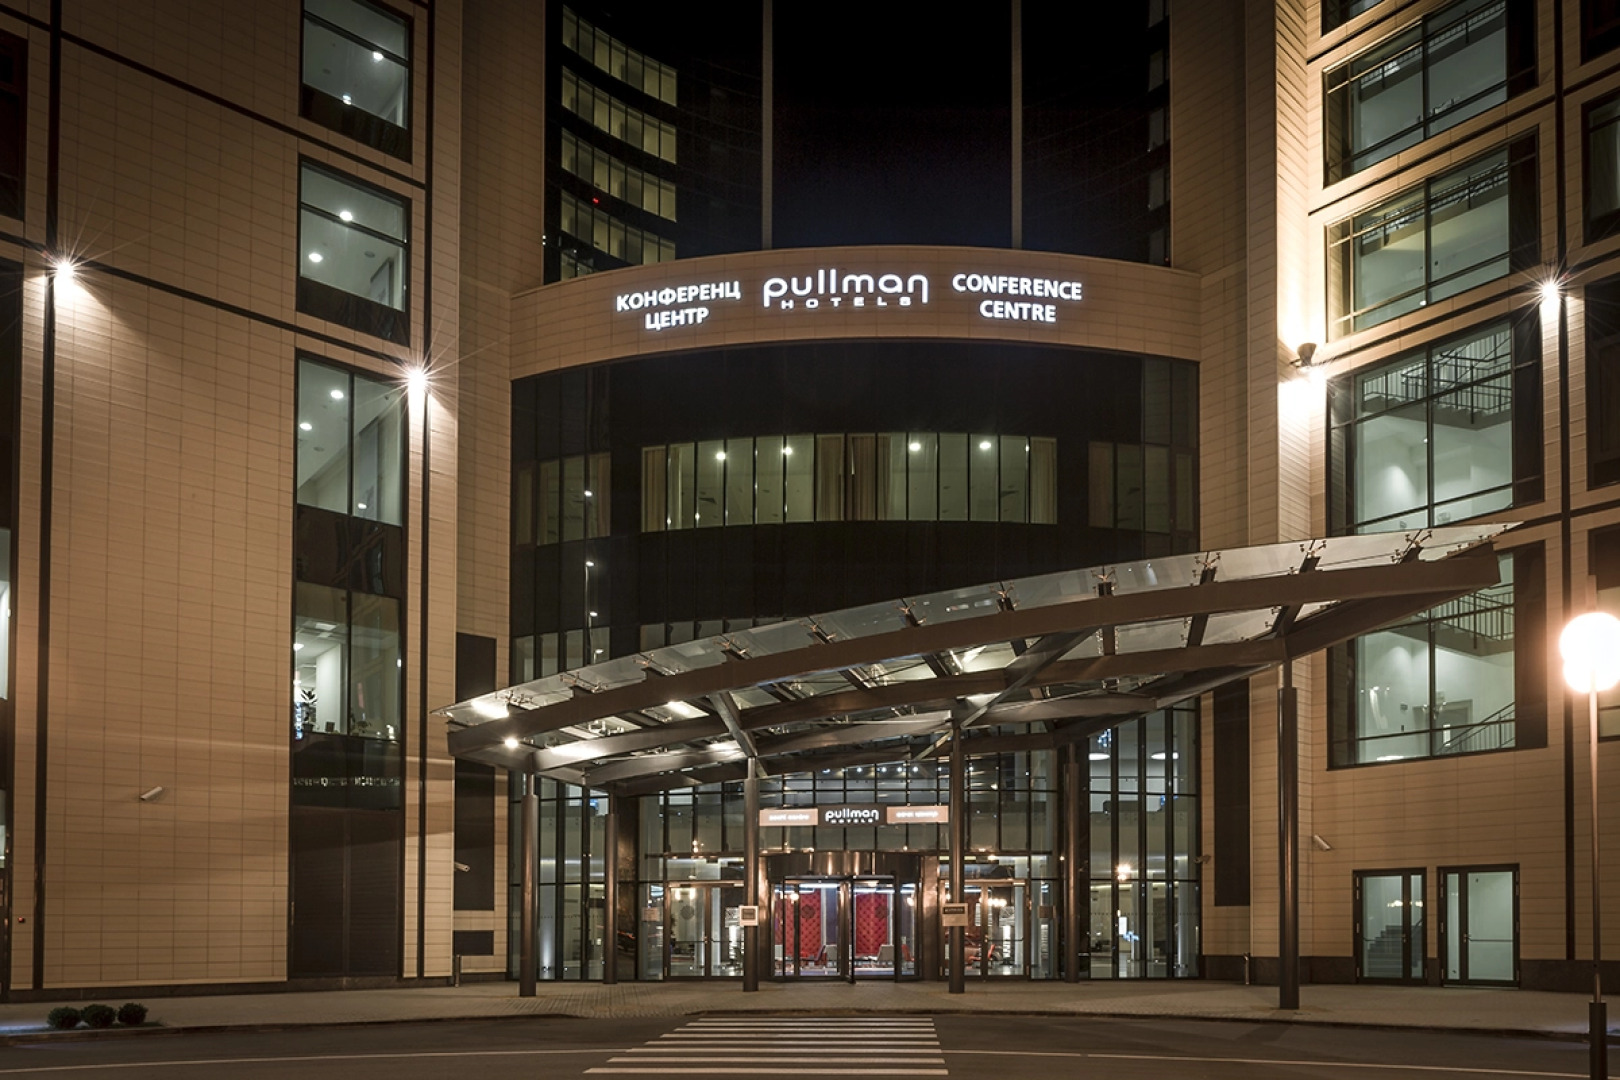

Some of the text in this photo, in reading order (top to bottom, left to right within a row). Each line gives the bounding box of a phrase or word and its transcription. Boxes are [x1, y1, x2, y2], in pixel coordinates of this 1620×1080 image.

[616, 280, 741, 312] КОНФЕРЕНЦ
[762, 268, 928, 308] pullman
[952, 273, 1082, 300] CONFERENCE
[645, 306, 709, 331] ЦЕНТР
[979, 300, 1056, 322] CENTRE
[825, 808, 879, 821] pullman
